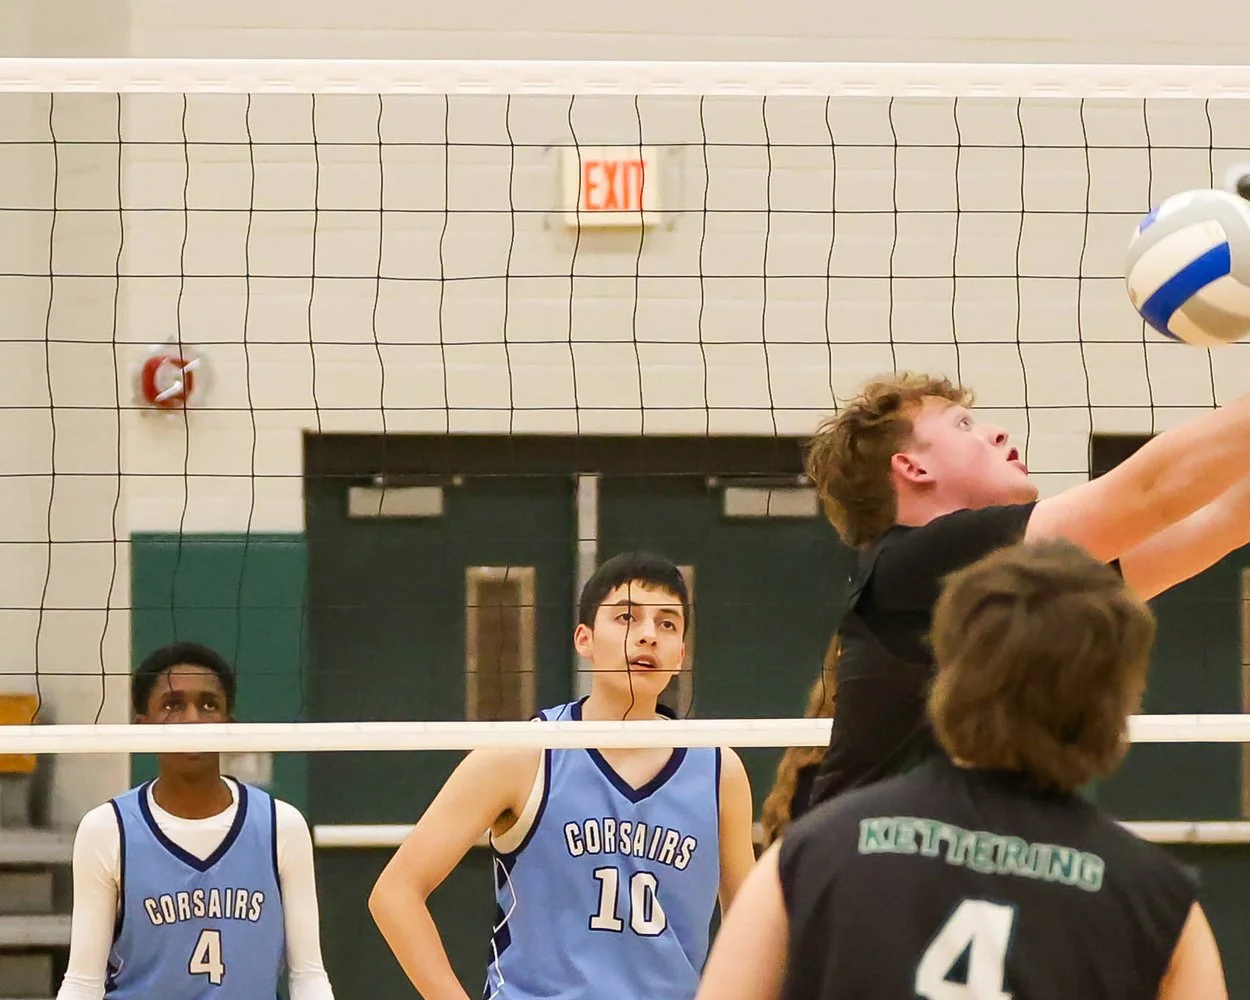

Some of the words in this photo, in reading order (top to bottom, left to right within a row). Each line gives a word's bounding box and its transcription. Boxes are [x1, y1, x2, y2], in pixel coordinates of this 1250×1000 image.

[583, 160, 647, 210] EXIT
[563, 818, 698, 871] CORSAIRS
[857, 816, 1106, 892] KETTERING
[144, 887, 265, 926] CORSAIRS
[588, 866, 668, 937] 10
[188, 929, 226, 986] 4
